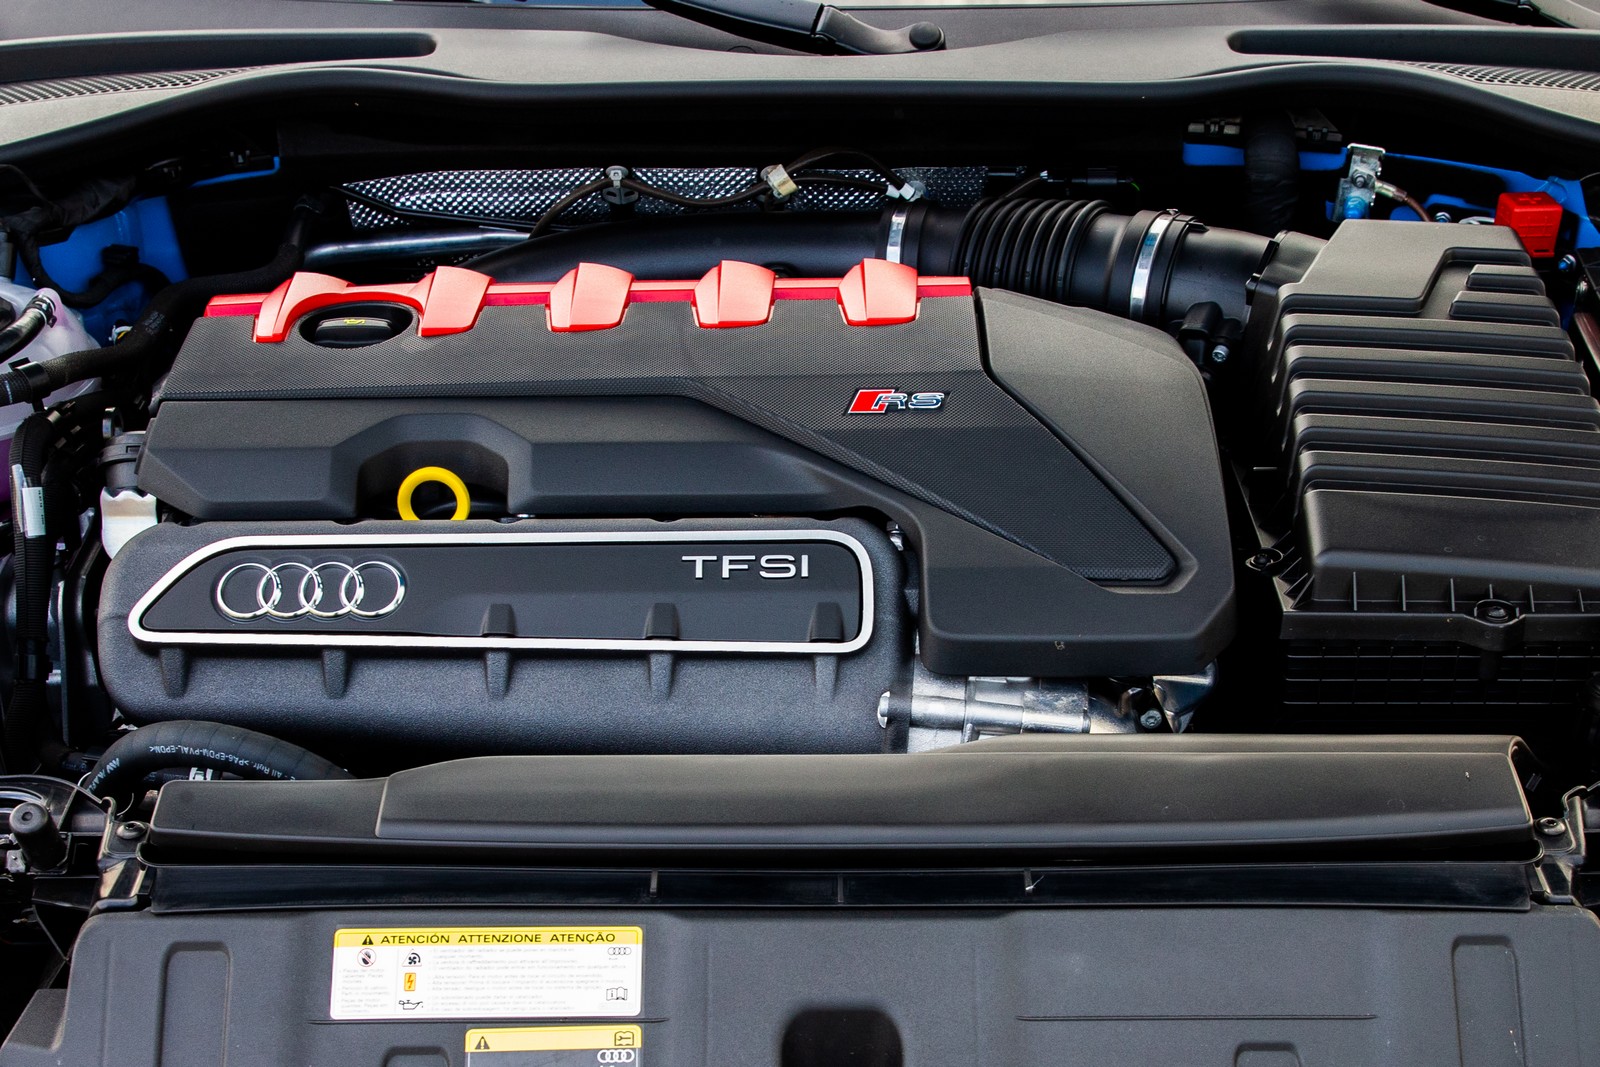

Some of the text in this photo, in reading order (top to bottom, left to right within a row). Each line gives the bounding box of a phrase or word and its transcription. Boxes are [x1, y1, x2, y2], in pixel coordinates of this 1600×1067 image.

[869, 391, 945, 410] RS
[682, 554, 809, 579] TFSI
[380, 931, 616, 944] ATENCIÓN ATTENZIONE ATENÇÃO
